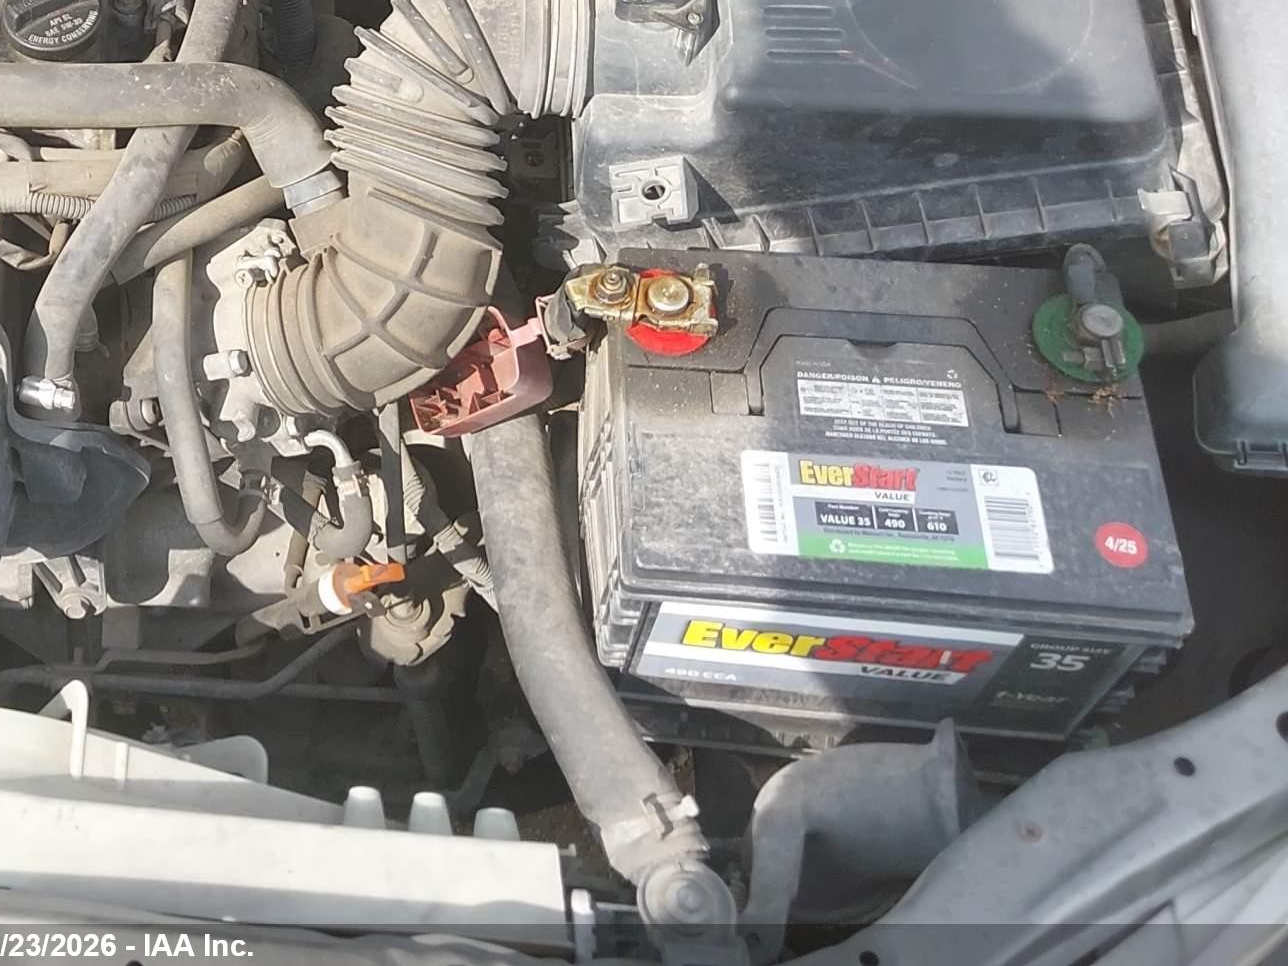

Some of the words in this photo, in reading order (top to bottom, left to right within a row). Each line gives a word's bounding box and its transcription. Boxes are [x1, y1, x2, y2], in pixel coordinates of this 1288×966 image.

[28, 34, 59, 45] ENERGY
[61, 10, 99, 43] CONSERVING
[49, 16, 62, 27] API
[44, 26, 60, 37] SAE
[797, 370, 869, 383] DANGER/POISON
[883, 376, 962, 388] PELIGRO/VENENO
[798, 458, 918, 492] EverStart
[874, 491, 910, 502] VALUE
[820, 513, 856, 526] VALUE
[857, 515, 872, 527] 35
[884, 518, 906, 530] 490
[926, 521, 947, 532] 610
[1104, 535, 1137, 554] 4/25
[680, 619, 993, 673] EverStart
[1029, 641, 1079, 653] GROUP
[1080, 643, 1112, 654] SIZE
[1029, 652, 1090, 672] 35
[858, 665, 953, 682] VALUE
